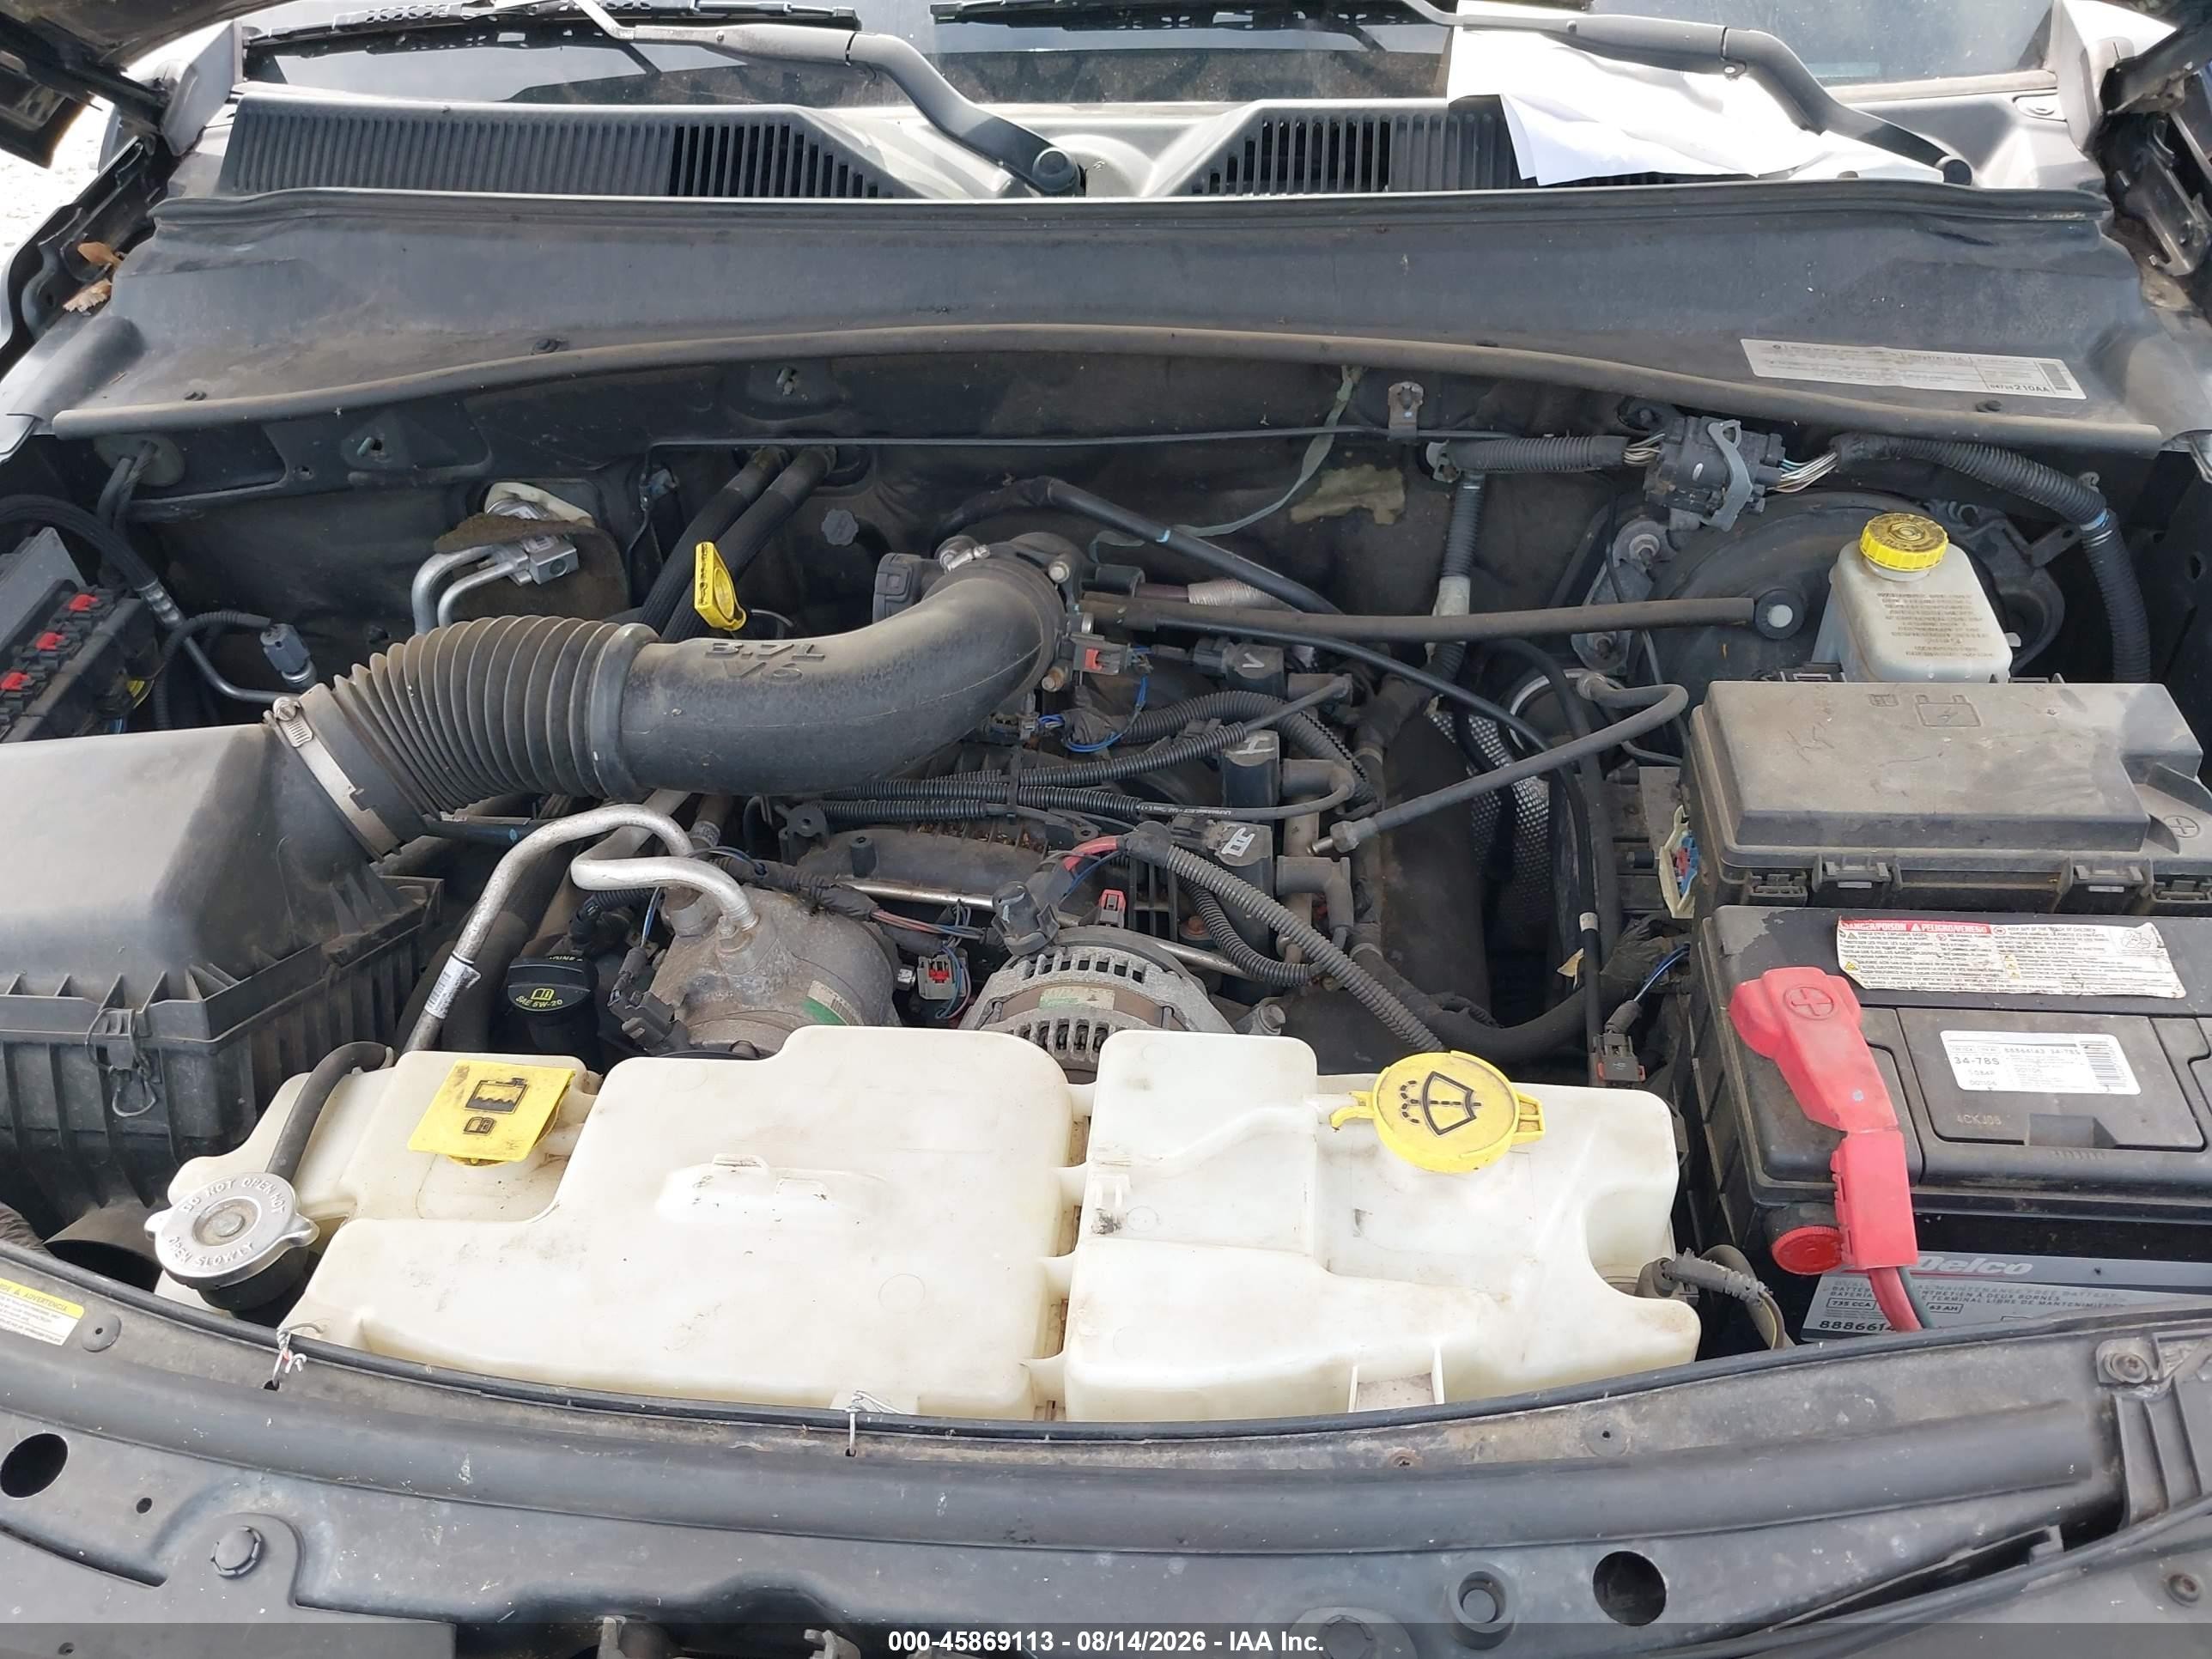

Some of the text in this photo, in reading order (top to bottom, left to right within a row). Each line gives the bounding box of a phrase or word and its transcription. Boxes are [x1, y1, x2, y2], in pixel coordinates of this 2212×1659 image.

[704, 642, 825, 662] 3.7L
[722, 661, 803, 684] V6
[516, 995, 563, 1008] SAE 5W-20
[1954, 1056, 2000, 1066] 34-78S
[205, 1179, 236, 1197] NOT
[241, 1177, 276, 1198] OPEN
